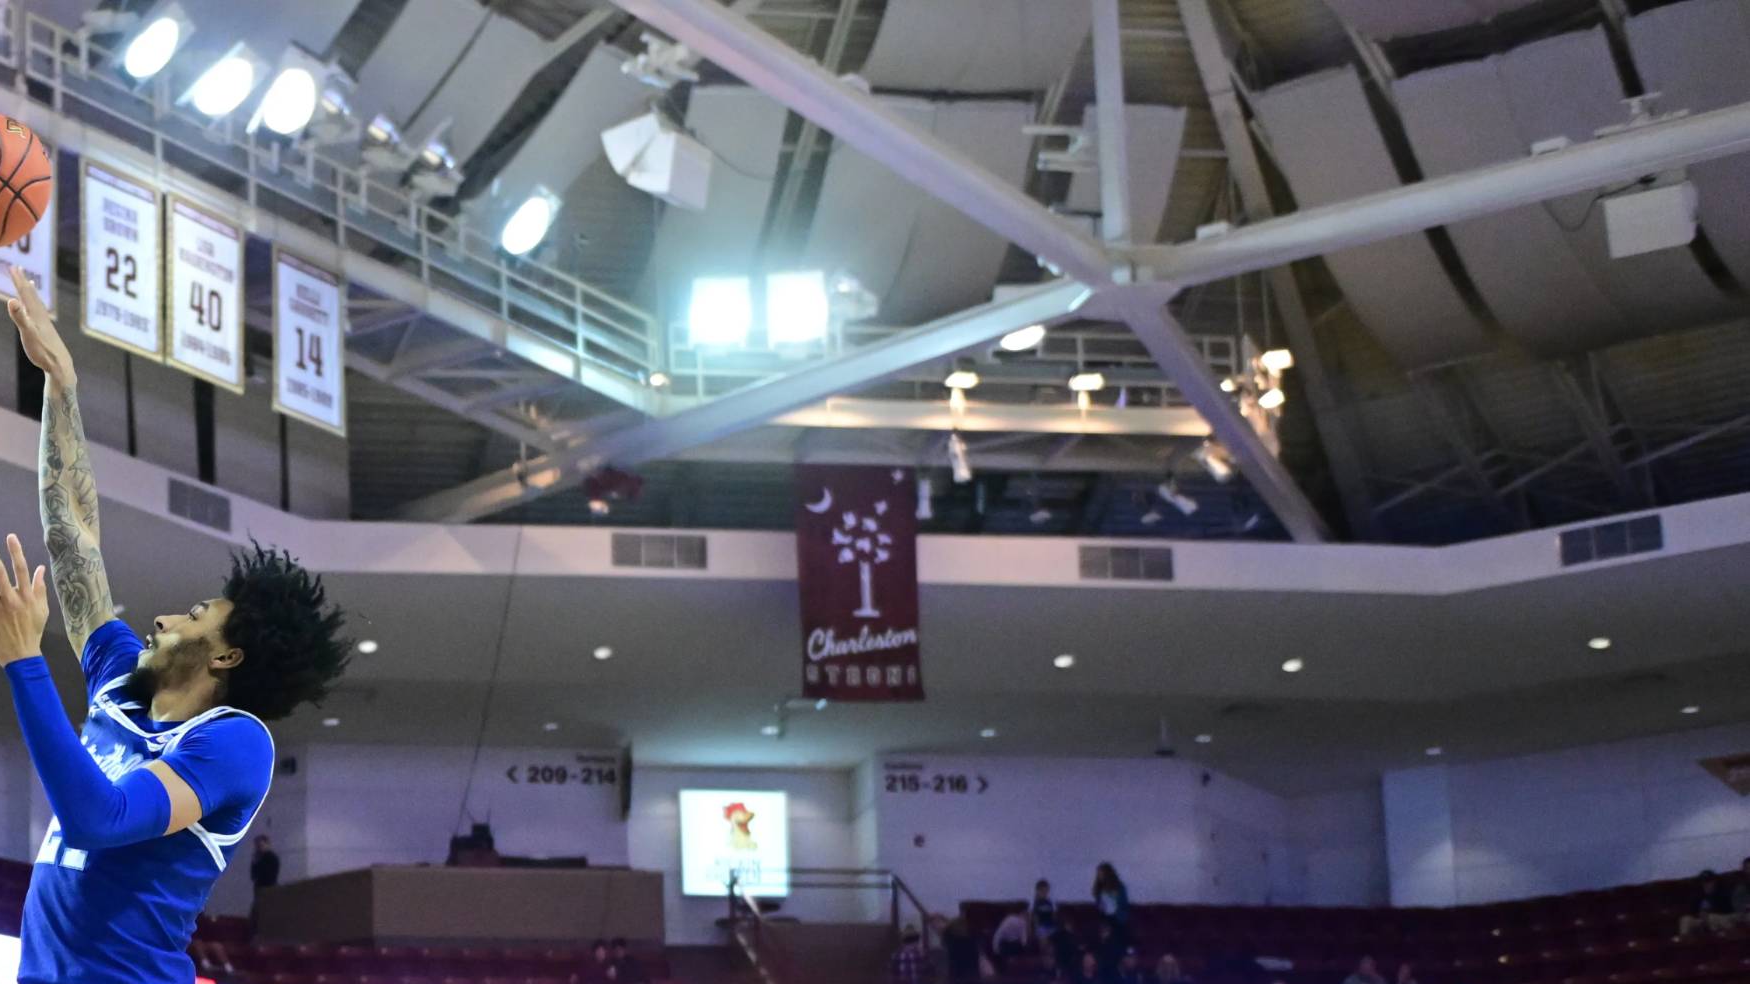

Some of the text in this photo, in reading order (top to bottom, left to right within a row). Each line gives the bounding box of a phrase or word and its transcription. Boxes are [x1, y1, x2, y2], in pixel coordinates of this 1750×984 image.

[106, 247, 137, 299] 22
[190, 280, 222, 331] 40
[296, 327, 324, 377] 14
[807, 624, 918, 662] Charleston
